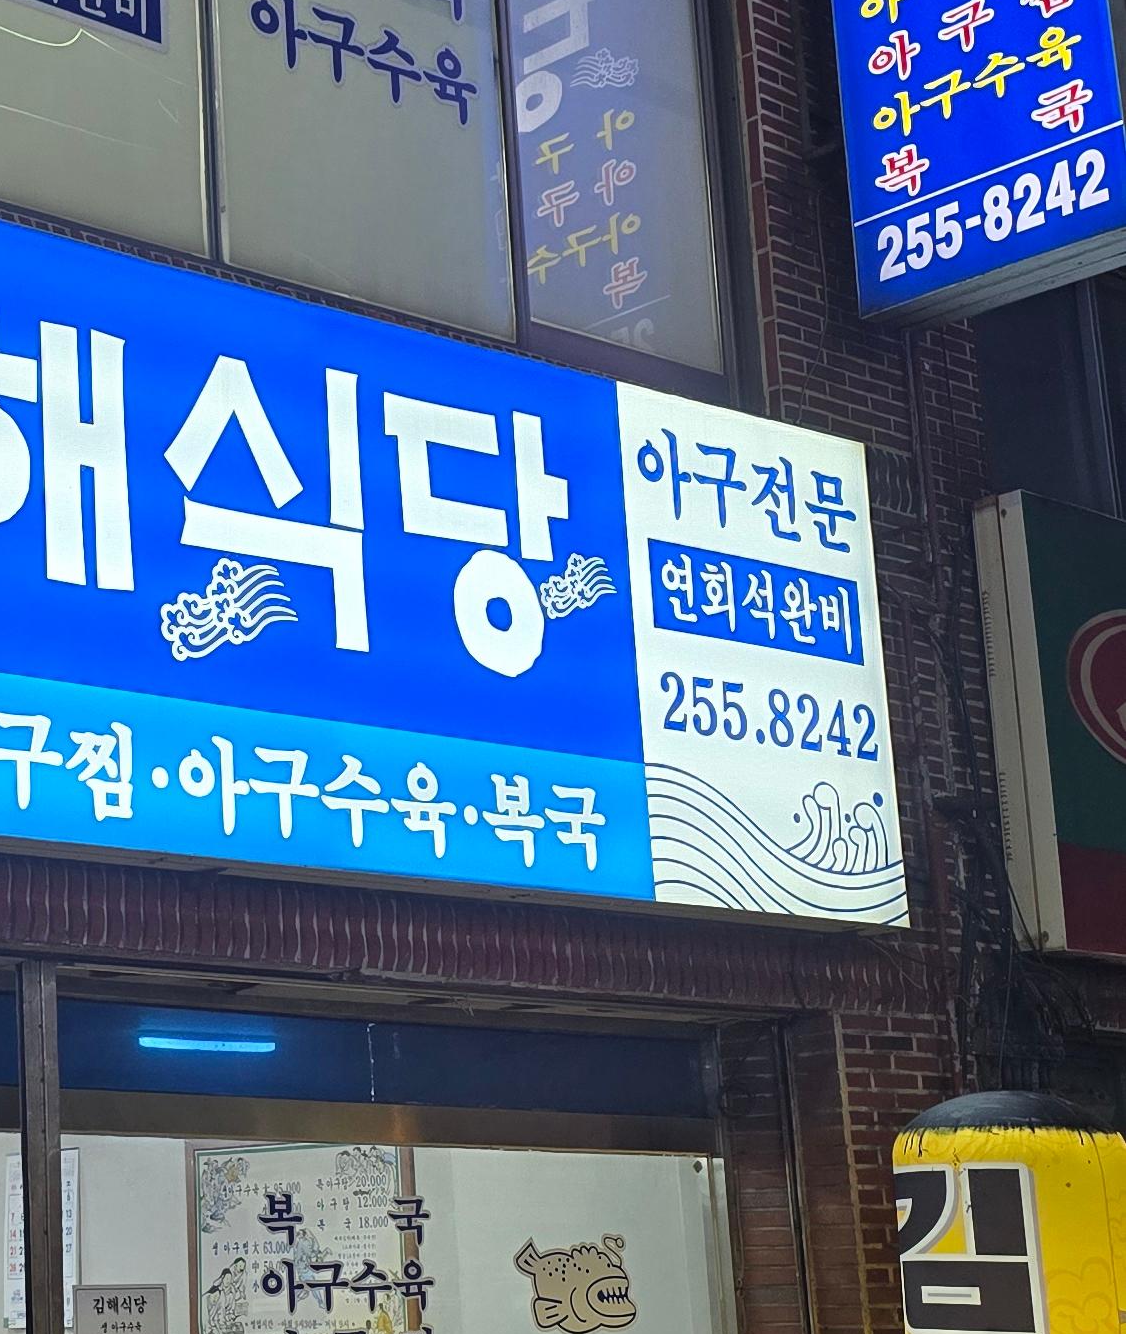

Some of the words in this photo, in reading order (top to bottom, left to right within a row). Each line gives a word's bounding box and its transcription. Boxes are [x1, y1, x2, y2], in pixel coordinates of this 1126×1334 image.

[872, 25, 1082, 138] 아구수육
[877, 147, 1110, 283] 255-8242
[636, 427, 858, 554] 아구전문
[660, 551, 853, 656] 연회석완비
[660, 670, 880, 763] 255.8242
[355, 1174, 387, 1188] 20.000
[357, 1195, 388, 1209] 12.000
[359, 1214, 389, 1229] 18.000
[93, 1295, 148, 1315] 김해식당
[260, 1259, 435, 1315] 아구수육
